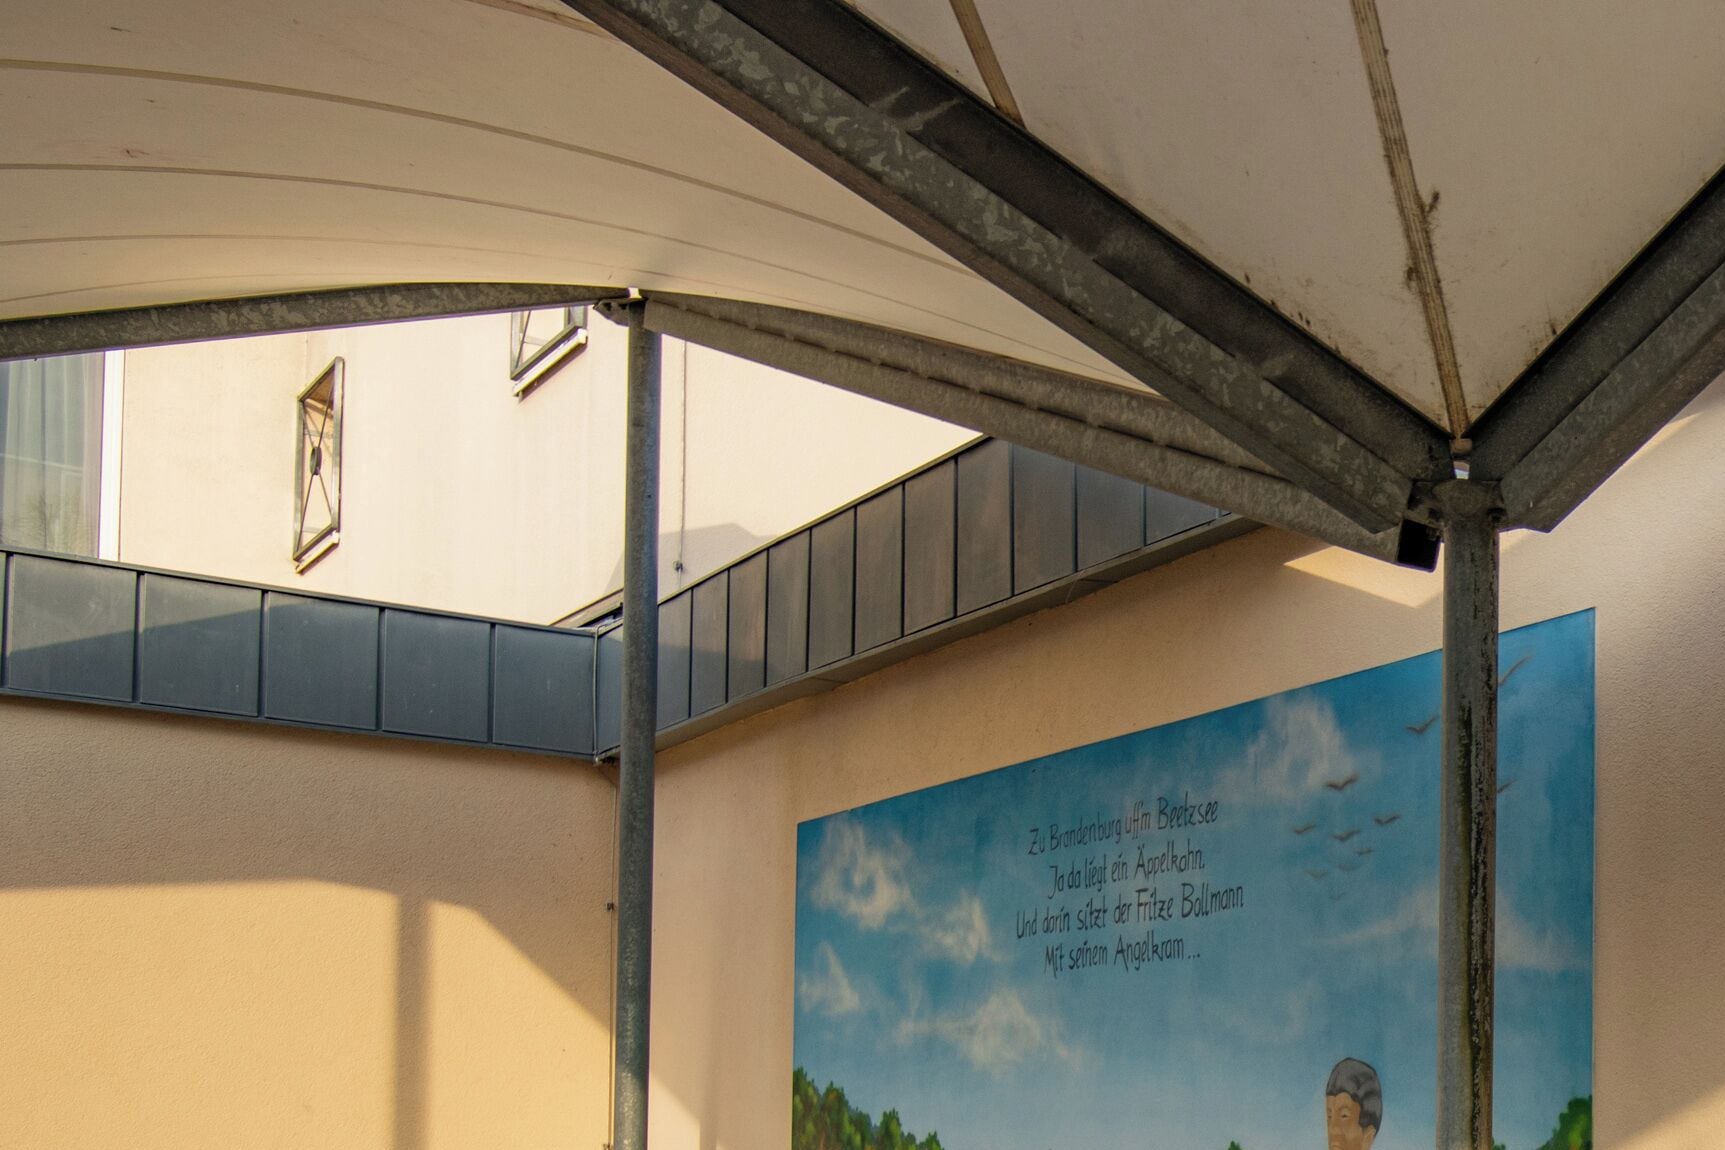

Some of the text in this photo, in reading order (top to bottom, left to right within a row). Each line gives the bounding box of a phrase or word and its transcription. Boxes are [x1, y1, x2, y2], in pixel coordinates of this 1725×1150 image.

[1028, 828, 1046, 856] Zu
[1050, 811, 1121, 851] Brandenburg
[1157, 791, 1218, 830] Beetzsee
[1048, 865, 1065, 899] Ja
[1068, 860, 1081, 889] da
[1084, 854, 1108, 892] liegt
[1112, 852, 1128, 882] ein
[1016, 882, 1243, 939] Und darin sitzt der Fritze Bollmann
[1044, 944, 1064, 979] Mit
[1069, 940, 1108, 970] seinem
